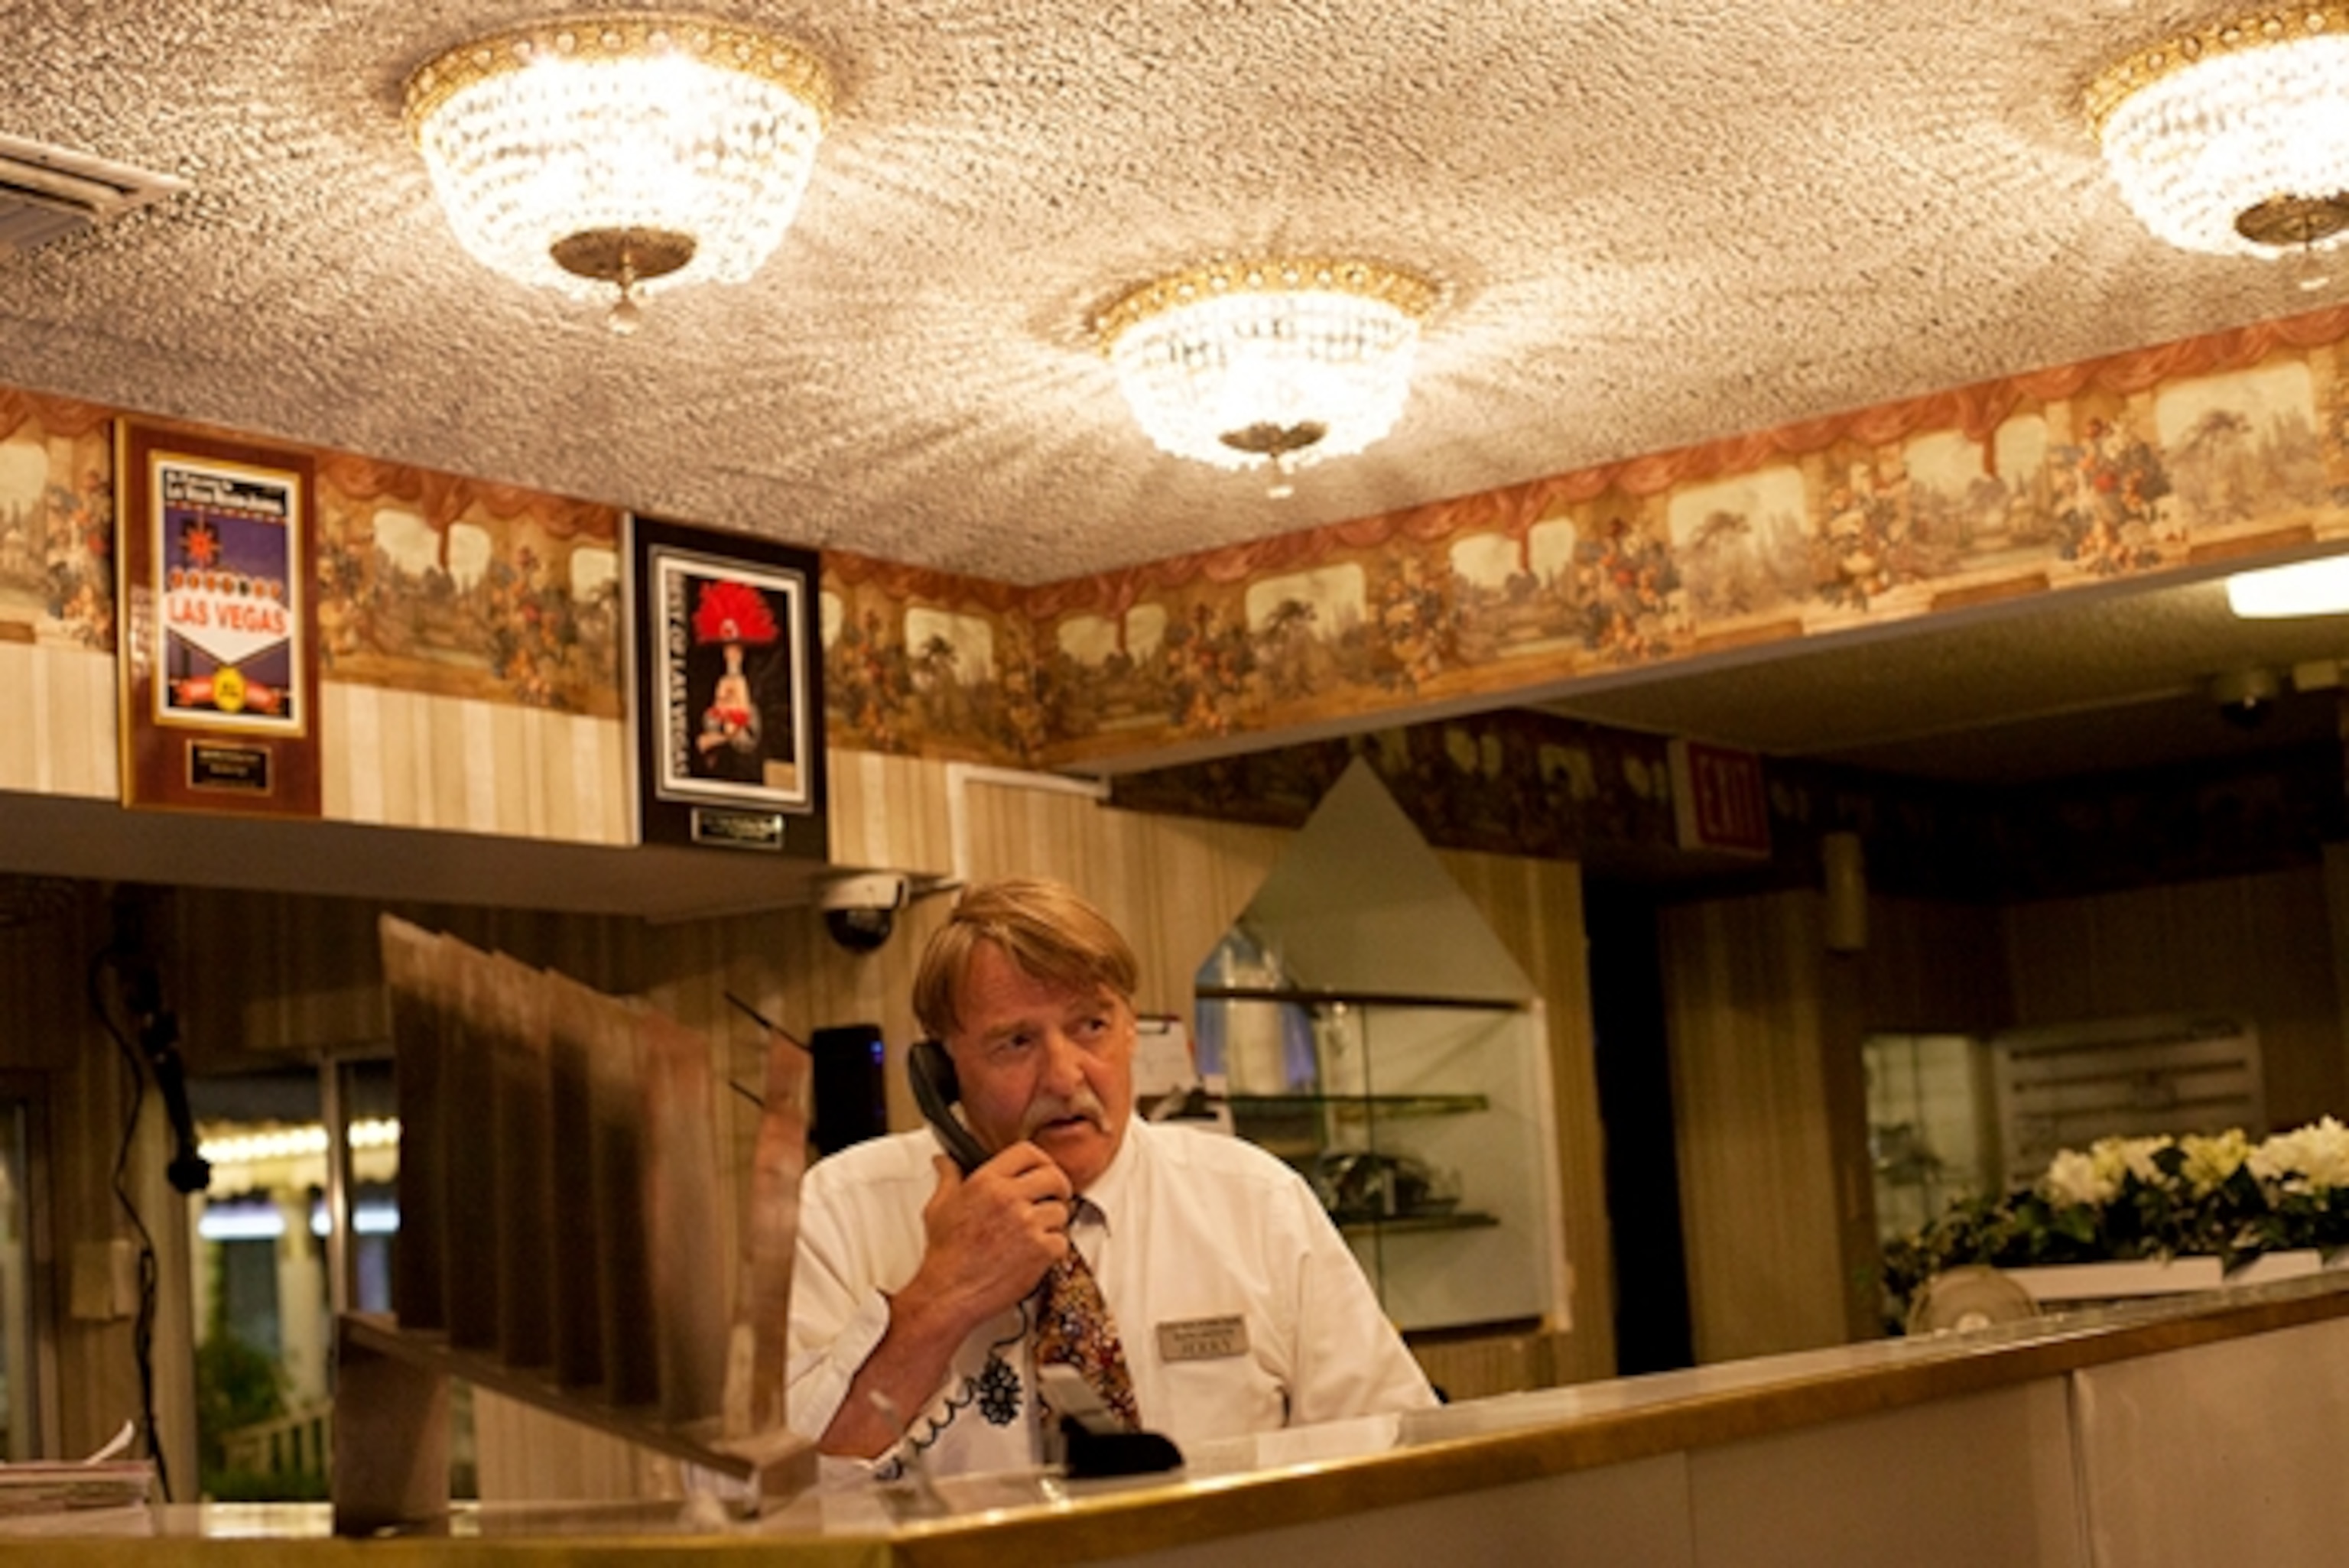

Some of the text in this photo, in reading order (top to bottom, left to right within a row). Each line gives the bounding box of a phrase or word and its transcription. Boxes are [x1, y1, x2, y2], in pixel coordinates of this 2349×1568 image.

[167, 596, 286, 632] LAS VEGAS
[670, 658, 687, 701] LAS
